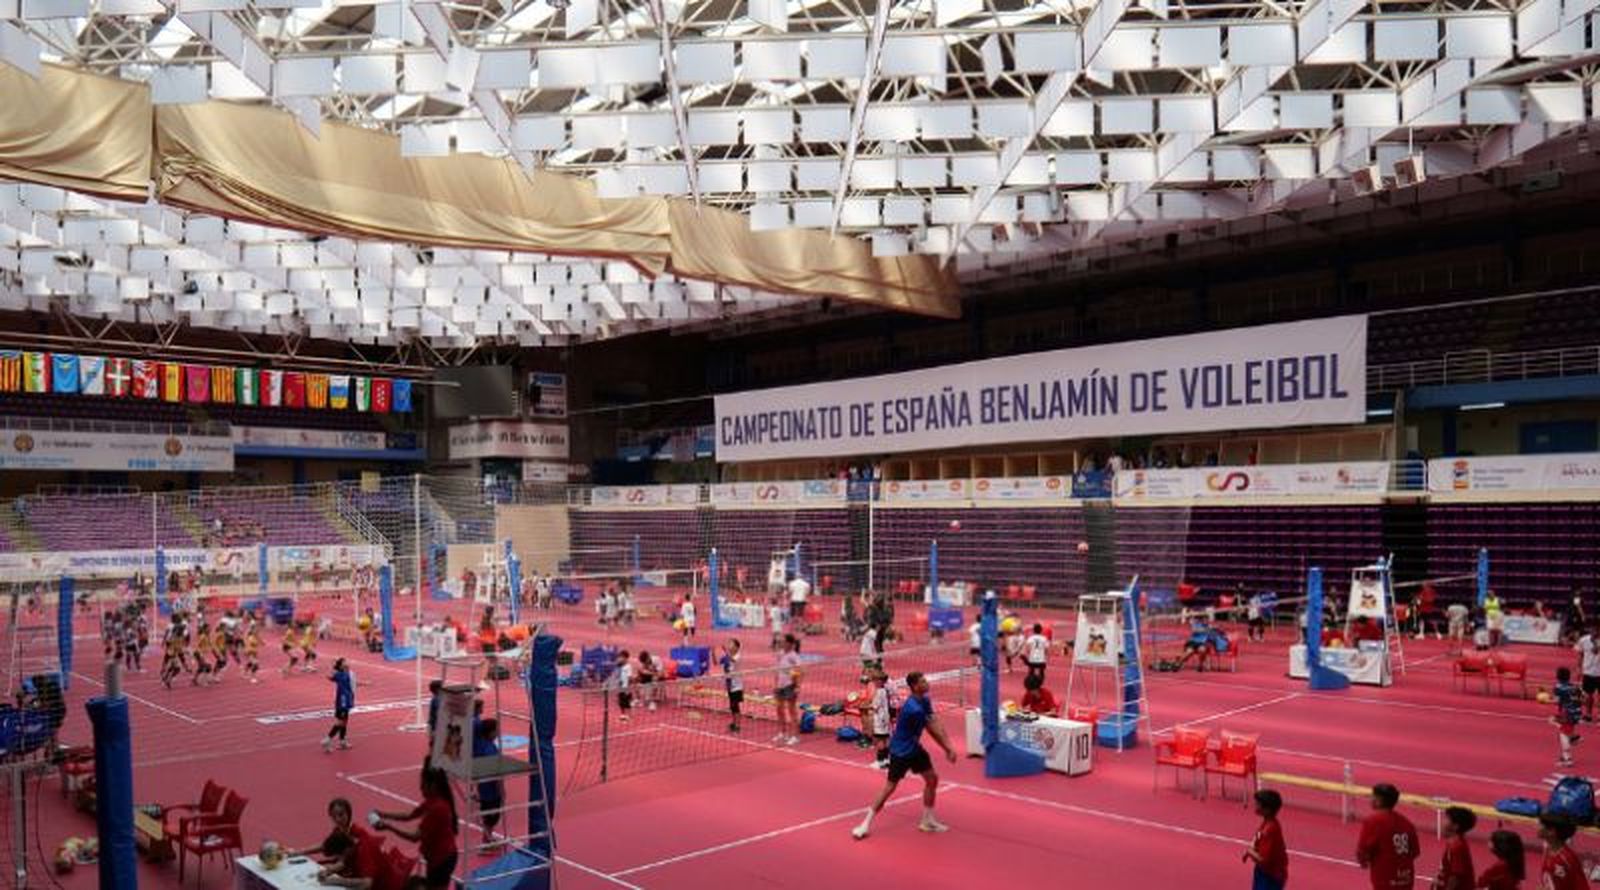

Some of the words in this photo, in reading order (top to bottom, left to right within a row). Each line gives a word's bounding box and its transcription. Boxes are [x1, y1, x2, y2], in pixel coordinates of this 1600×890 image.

[721, 406, 842, 446] CAMPEONATO
[850, 402, 875, 437] DE
[883, 387, 972, 434] ESPAÑA
[980, 367, 1119, 425] BENJAMÍN
[1130, 370, 1168, 413] DE
[1180, 353, 1348, 409] VOLEIBOL
